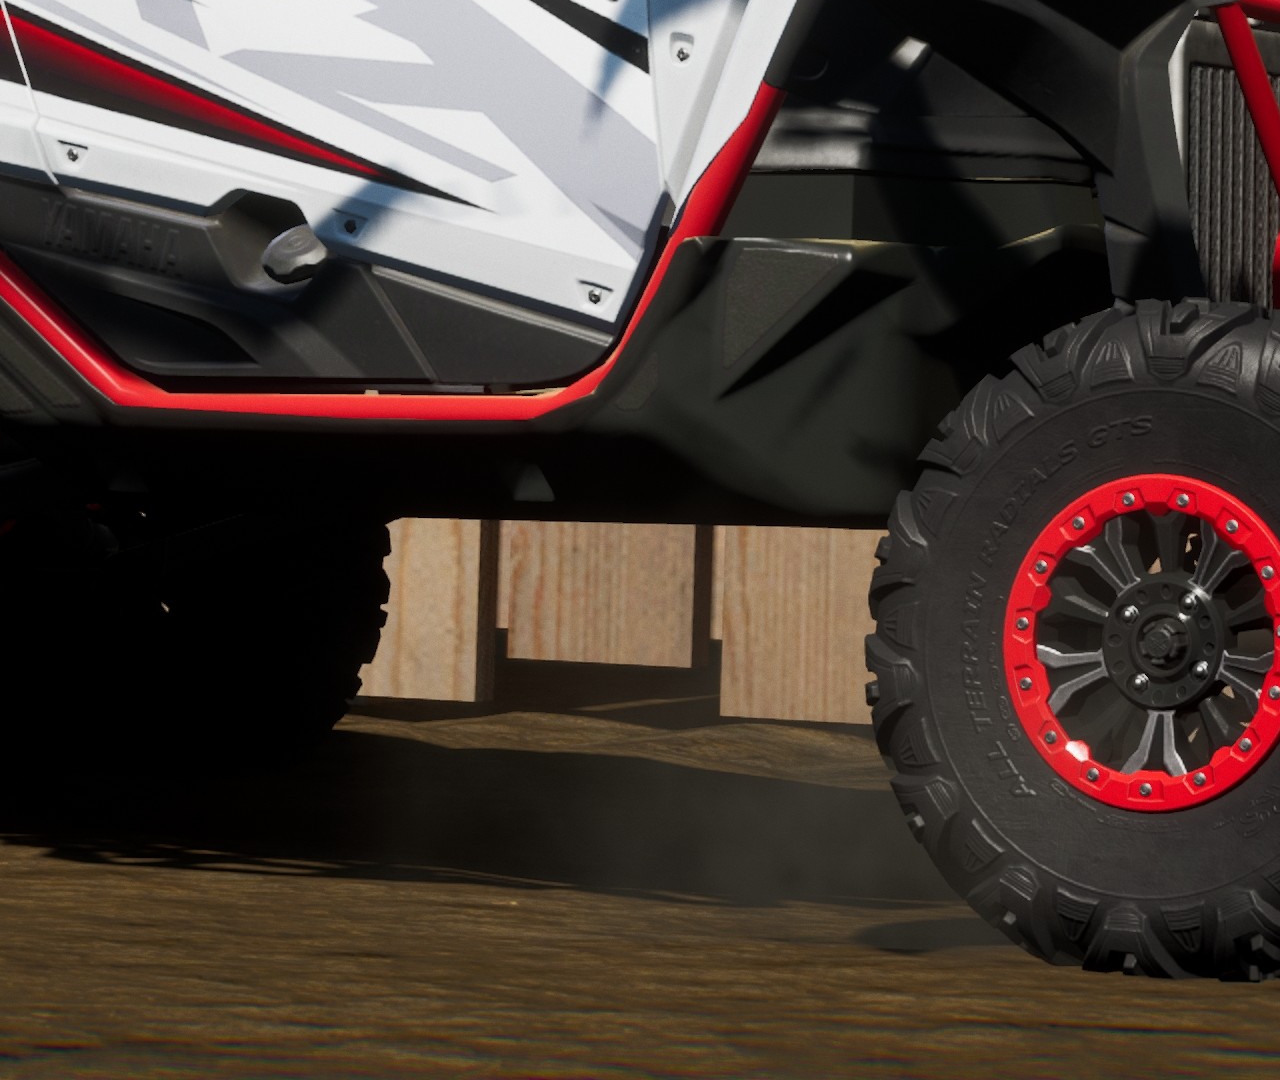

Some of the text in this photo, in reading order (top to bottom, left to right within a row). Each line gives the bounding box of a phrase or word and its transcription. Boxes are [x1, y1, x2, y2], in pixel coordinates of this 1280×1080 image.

[41, 196, 183, 277] YAMAHA
[960, 576, 992, 734] TERRAIN
[978, 443, 1078, 565] RADIALS
[1086, 416, 1153, 449] GTS
